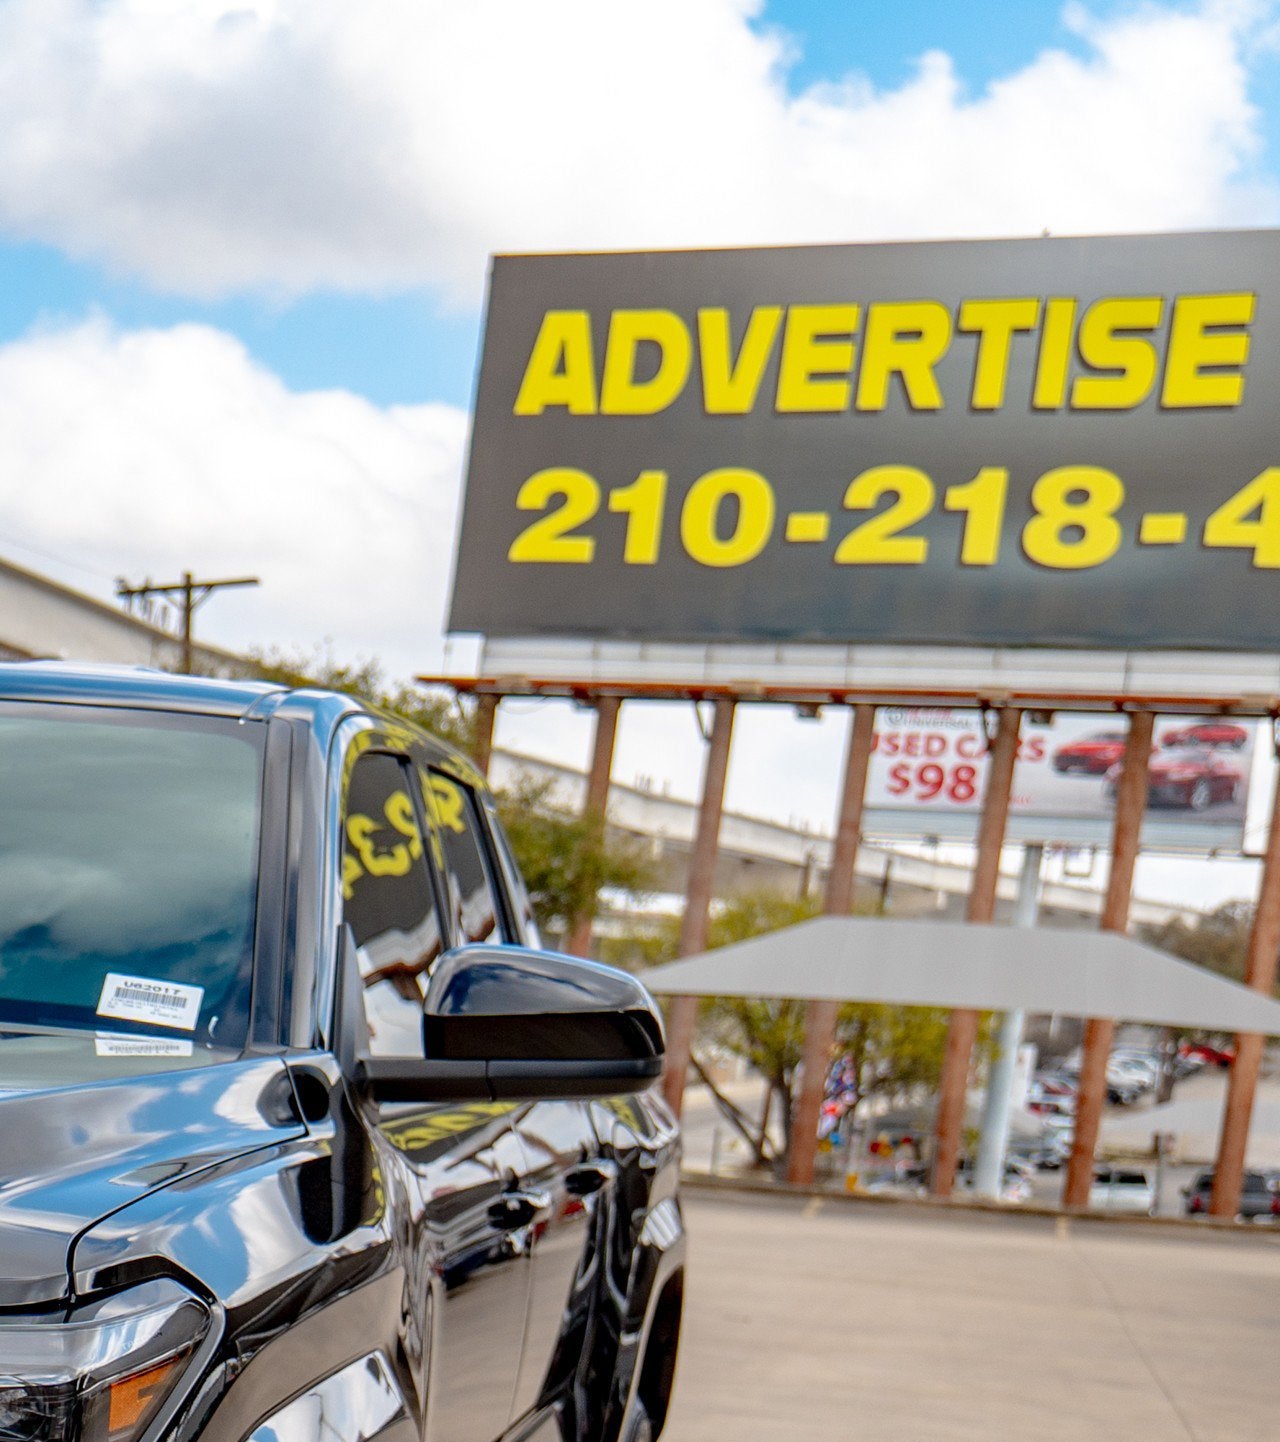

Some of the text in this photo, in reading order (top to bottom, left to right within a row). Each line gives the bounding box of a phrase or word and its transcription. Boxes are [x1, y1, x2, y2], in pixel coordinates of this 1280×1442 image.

[513, 292, 1255, 416] ADVERTISE
[508, 464, 1280, 570] 210-218-4
[887, 763, 977, 804] $98
[955, 733, 1045, 763] CS
